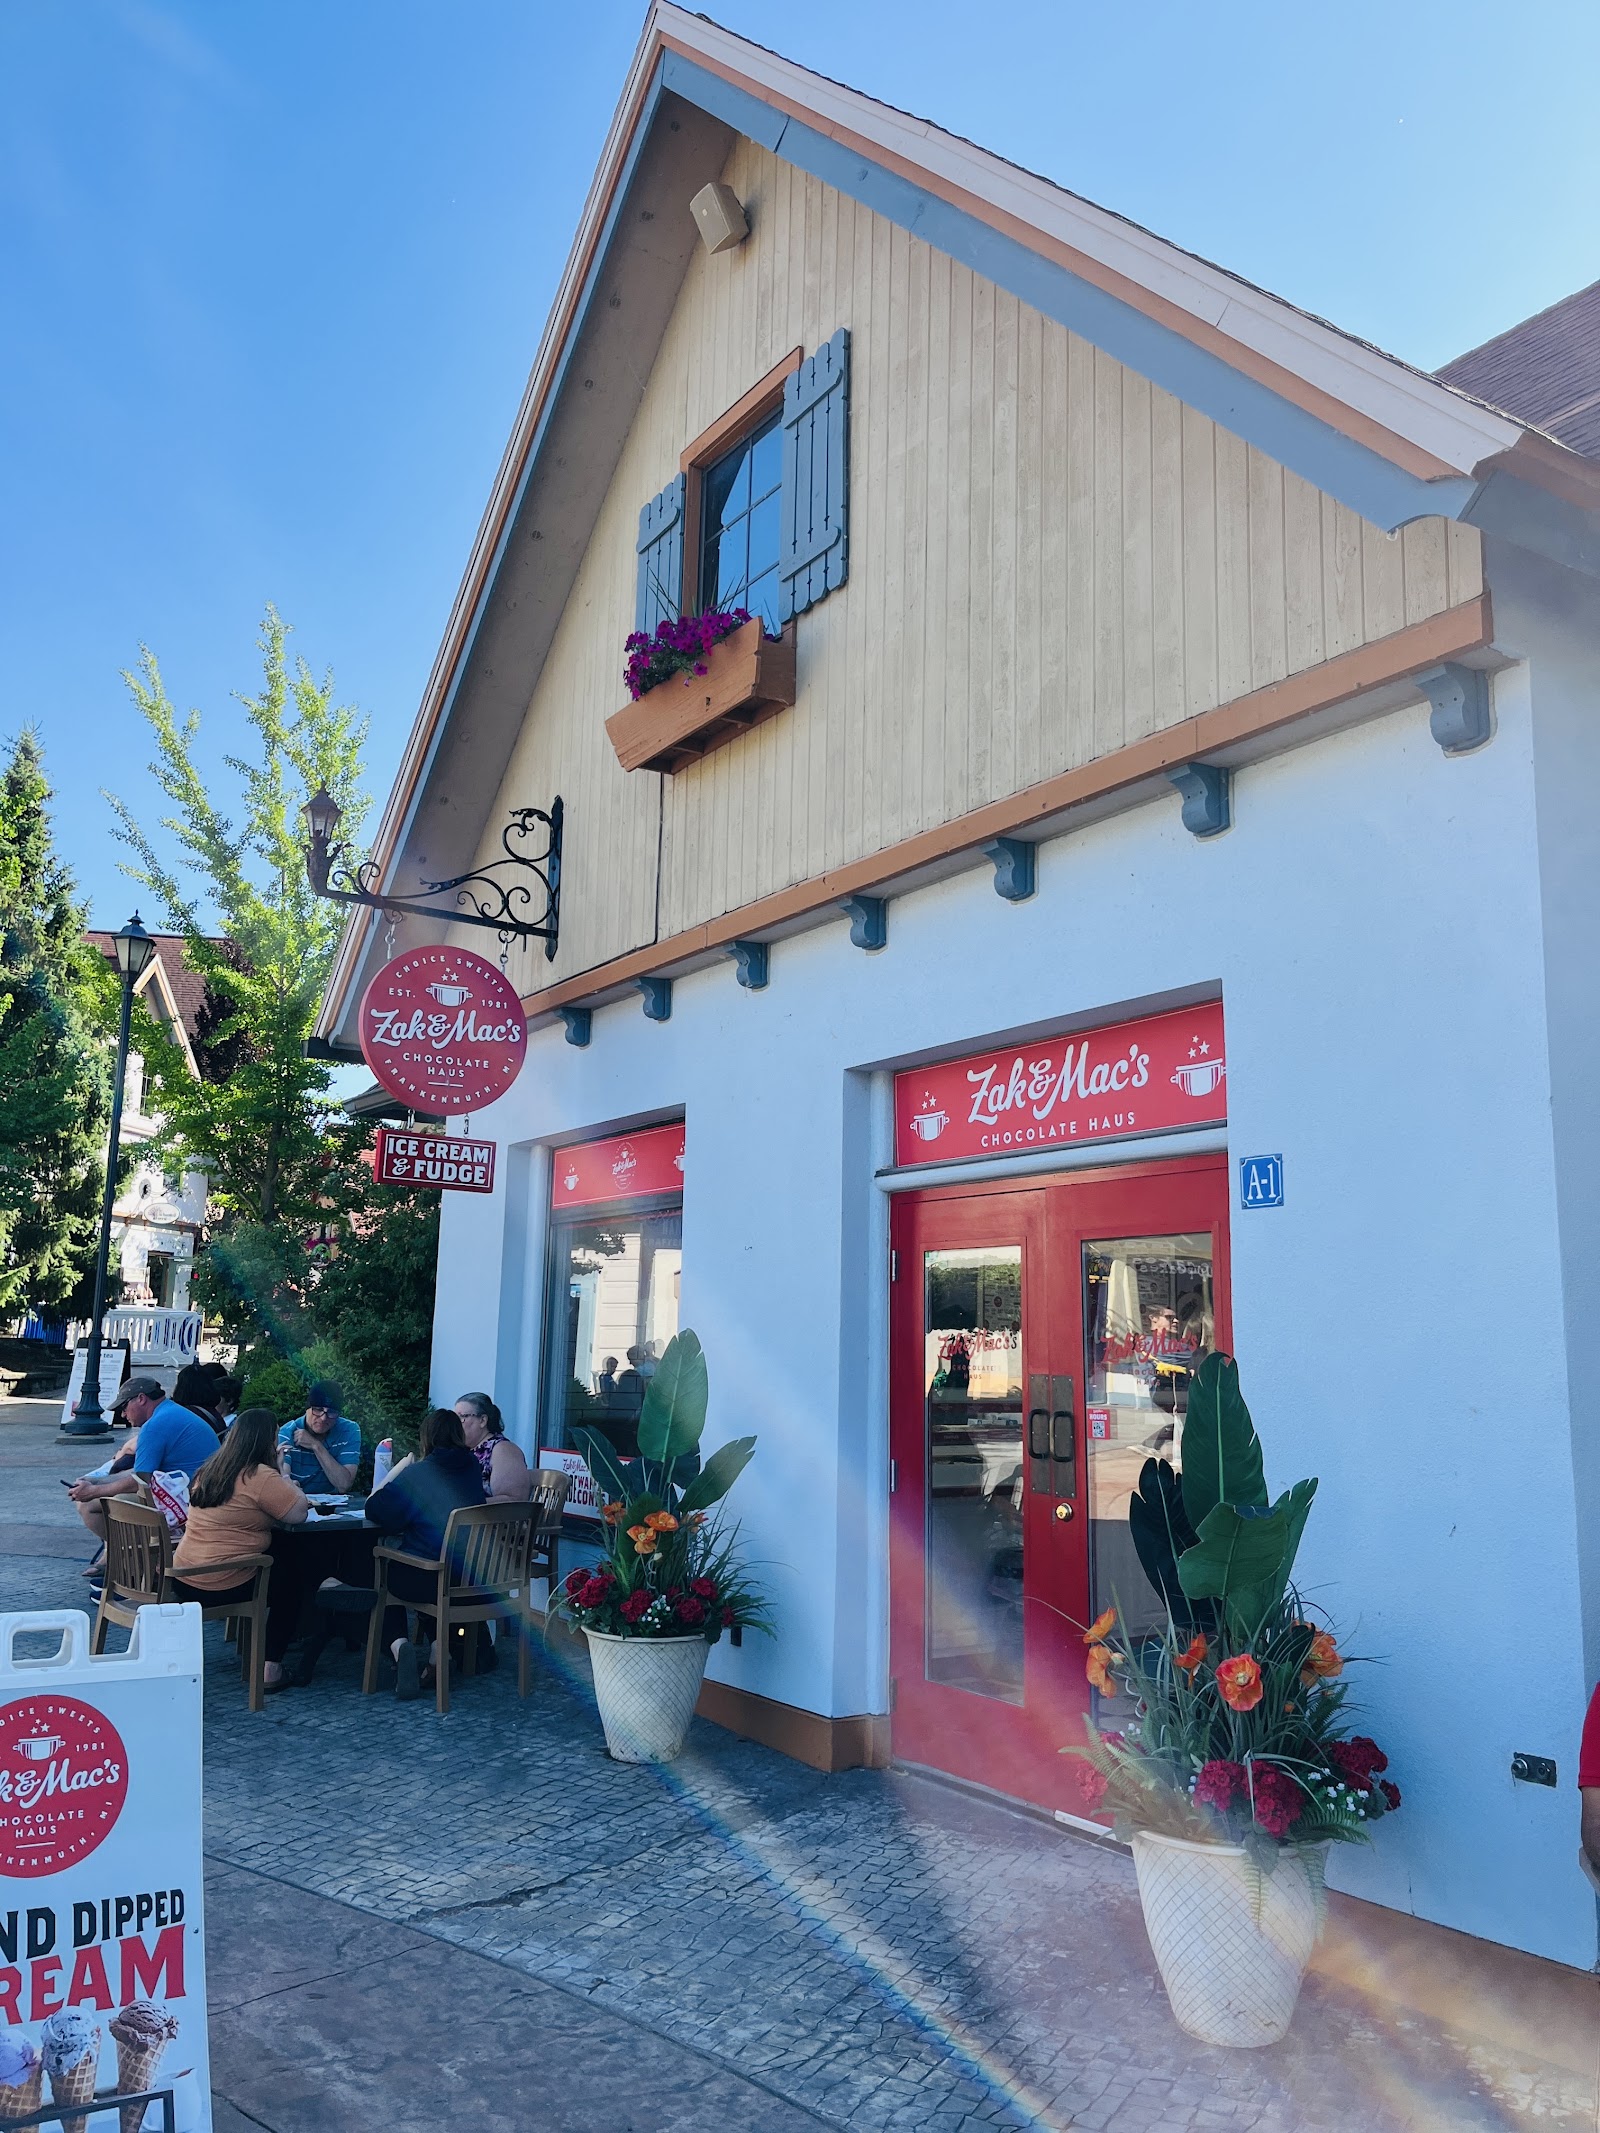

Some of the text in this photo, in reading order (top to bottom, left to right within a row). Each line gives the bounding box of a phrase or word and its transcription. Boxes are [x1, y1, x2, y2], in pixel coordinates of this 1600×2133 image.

[396, 955, 504, 993] CHOICE SWEETS
[388, 987, 508, 1009] EST. 1981
[403, 1052, 490, 1069] CHOCOLATE
[428, 1066, 465, 1078] HAUS
[502, 1057, 514, 1074] MI
[980, 1111, 1136, 1148] CHOCOLATE HAUS
[387, 1137, 489, 1164] ICE CREAM
[392, 1158, 486, 1185] & FUDGE
[1246, 1163, 1278, 1201] A-1
[963, 1372, 983, 1380] HAUS
[1088, 1413, 1108, 1421] HOURS
[48, 1706, 101, 1734] SWEETS
[75, 1742, 106, 1752] 1981
[0, 1801, 113, 1867] KENMUTH, MI
[15, 1825, 58, 1839] HAUS
[72, 1888, 185, 1948] DIPPED
